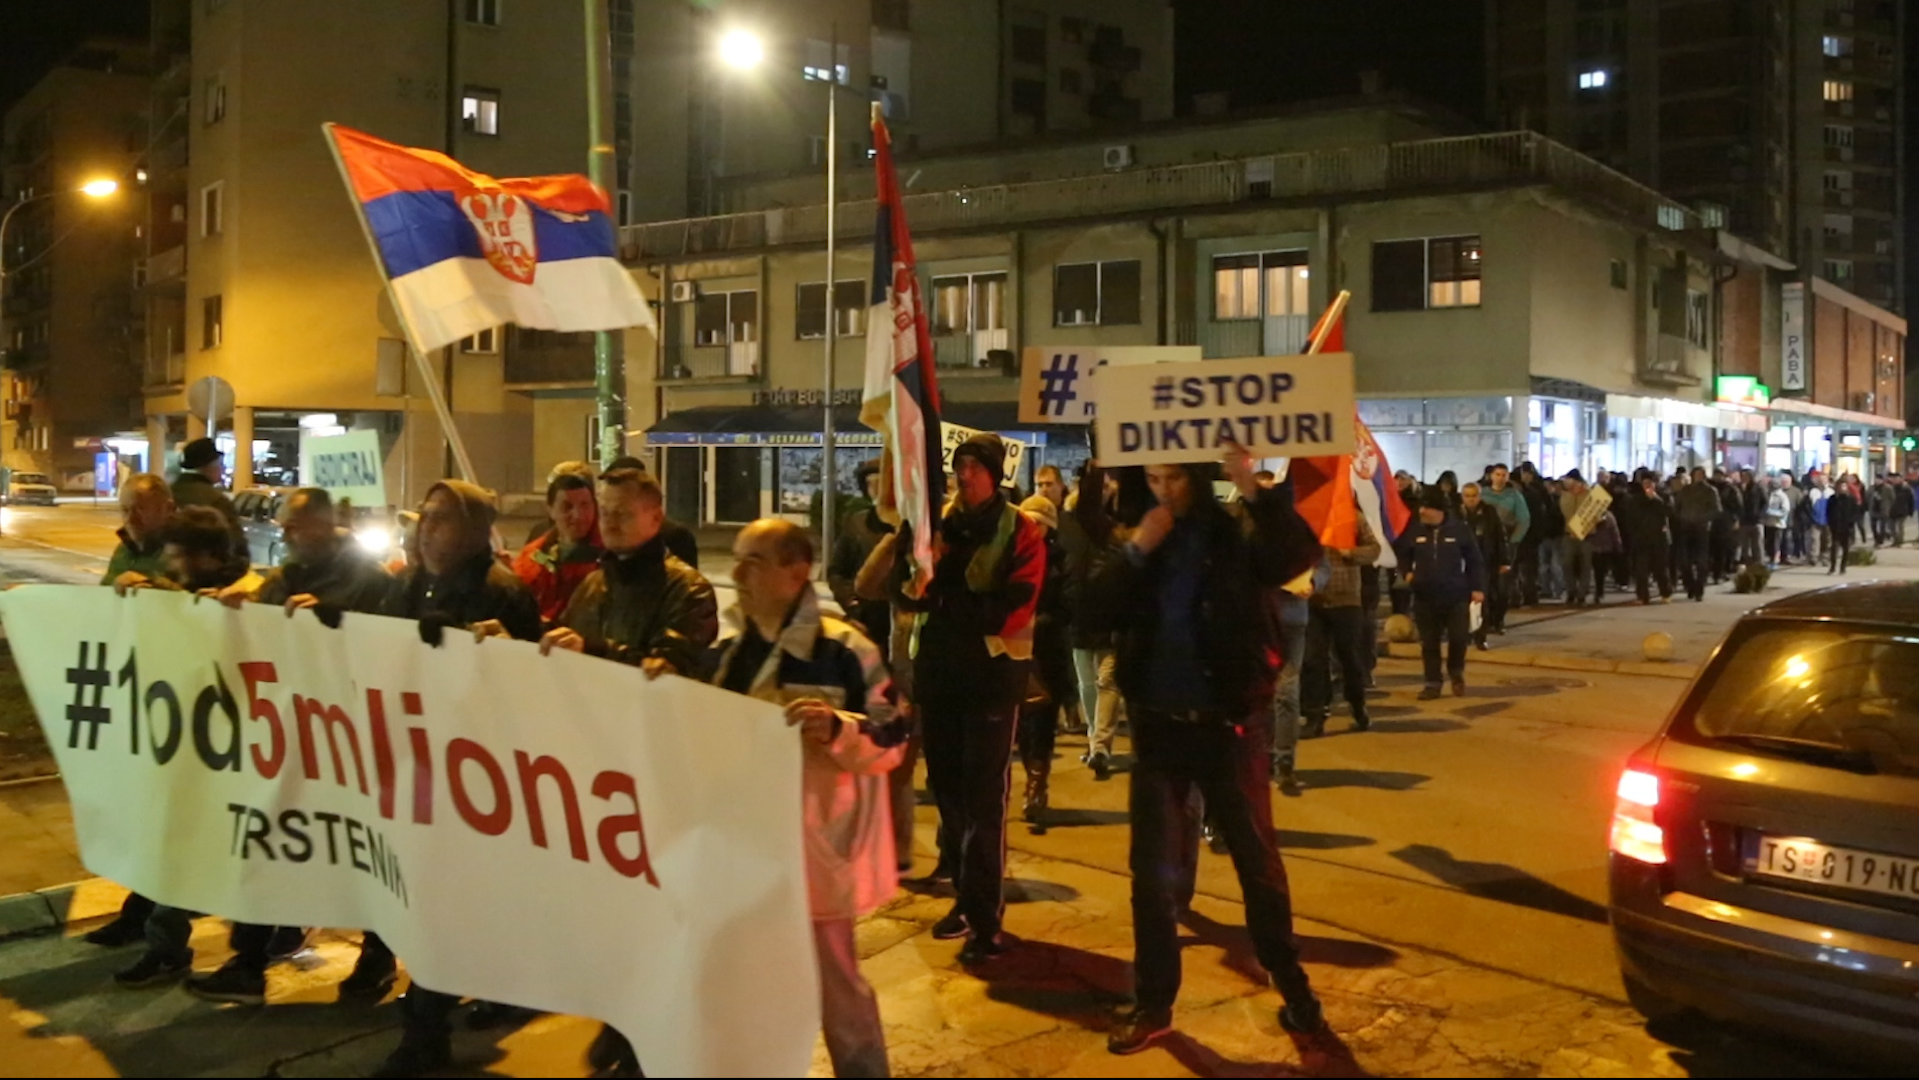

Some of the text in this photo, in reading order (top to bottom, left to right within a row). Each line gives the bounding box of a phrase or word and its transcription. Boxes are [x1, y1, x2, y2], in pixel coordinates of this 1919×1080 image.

[1152, 372, 1294, 410] #STOP
[1119, 412, 1333, 453] DIKTATURI
[1766, 843, 1798, 873] TS
